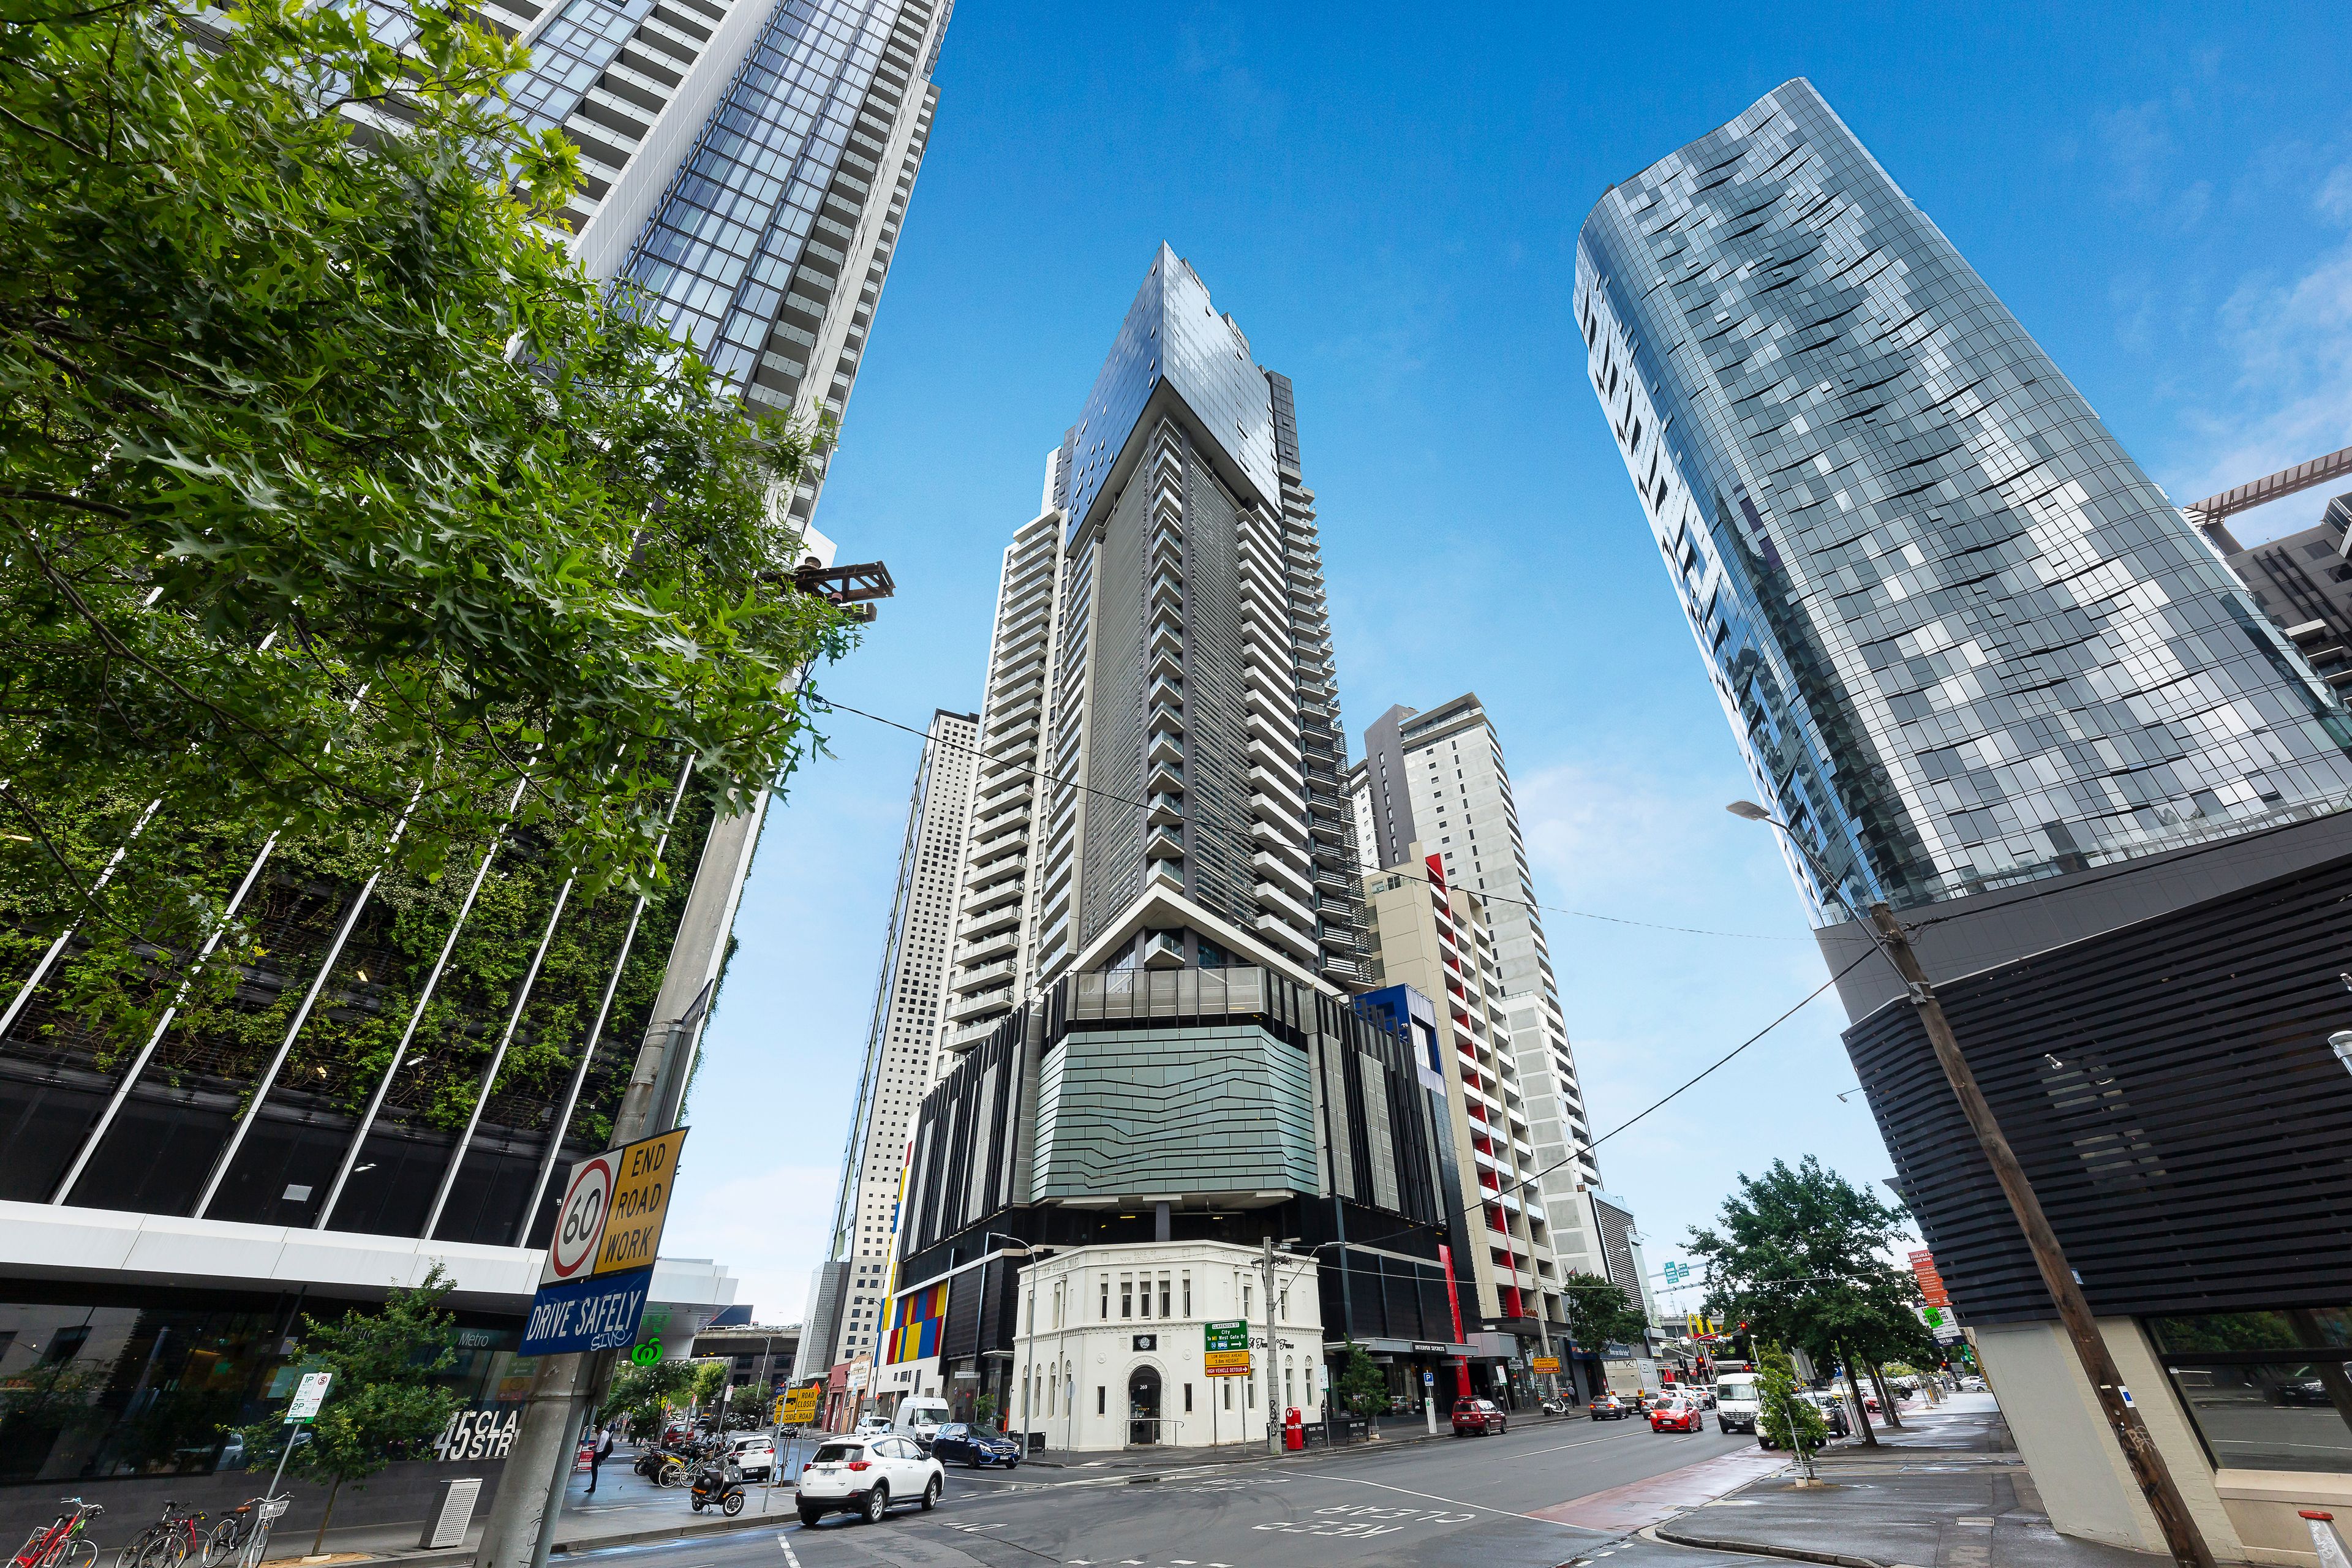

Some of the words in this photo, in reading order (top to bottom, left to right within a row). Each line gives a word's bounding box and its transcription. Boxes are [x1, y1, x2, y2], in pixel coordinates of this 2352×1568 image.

[631, 1143, 666, 1178] END
[615, 1183, 662, 1220] ROAD
[563, 1188, 601, 1245] 60
[605, 1226, 654, 1264] WORK
[526, 1300, 575, 1341] DRIVE
[575, 1290, 641, 1336] SAFELY
[1928, 1312, 1940, 1323] SOLD
[459, 1333, 489, 1347] Metro
[1249, 1338, 1255, 1349] A
[434, 1411, 477, 1461] 45
[475, 1411, 518, 1434] CLA
[468, 1430, 521, 1458] STR
[1313, 1504, 1476, 1524] CLEAR
[1251, 1520, 1404, 1539] KEEP
